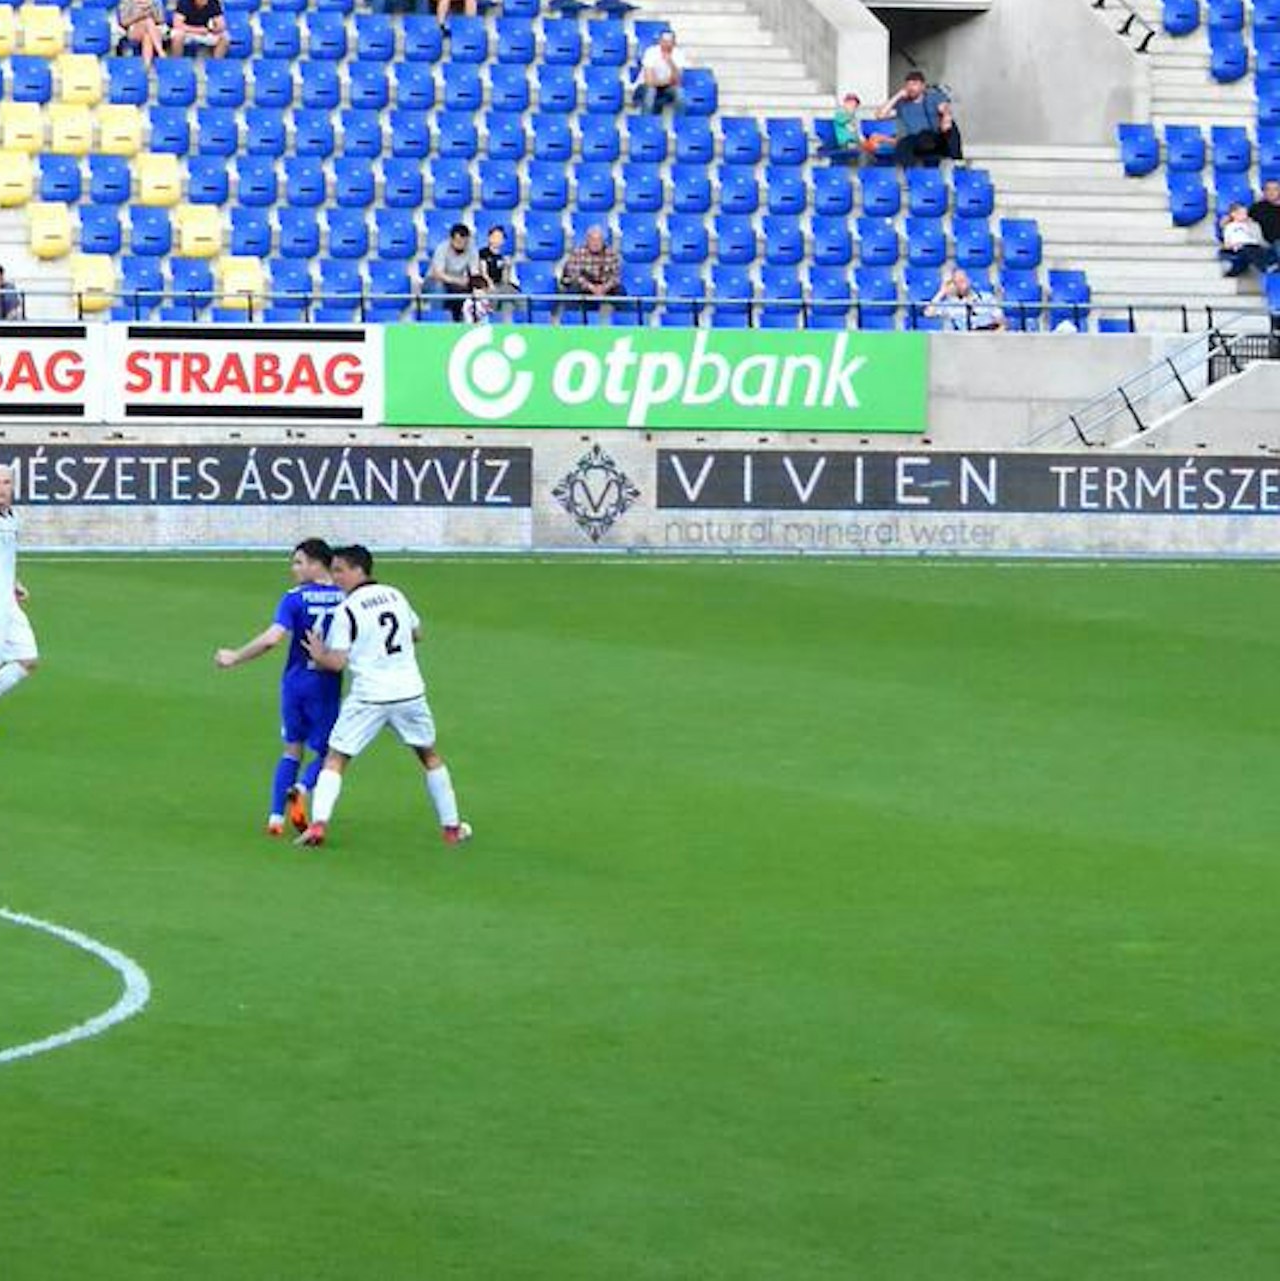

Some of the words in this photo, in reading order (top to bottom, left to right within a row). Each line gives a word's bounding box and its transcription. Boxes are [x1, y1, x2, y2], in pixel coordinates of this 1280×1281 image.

[125, 350, 362, 397] STRABAG
[552, 331, 866, 426] otpbank
[235, 447, 512, 503] ÁSVÁNYVÍZ
[671, 455, 997, 506] VIVIEN
[665, 517, 774, 544] natural
[783, 519, 901, 545] mineral
[911, 522, 998, 545] water
[377, 611, 402, 655] 2
